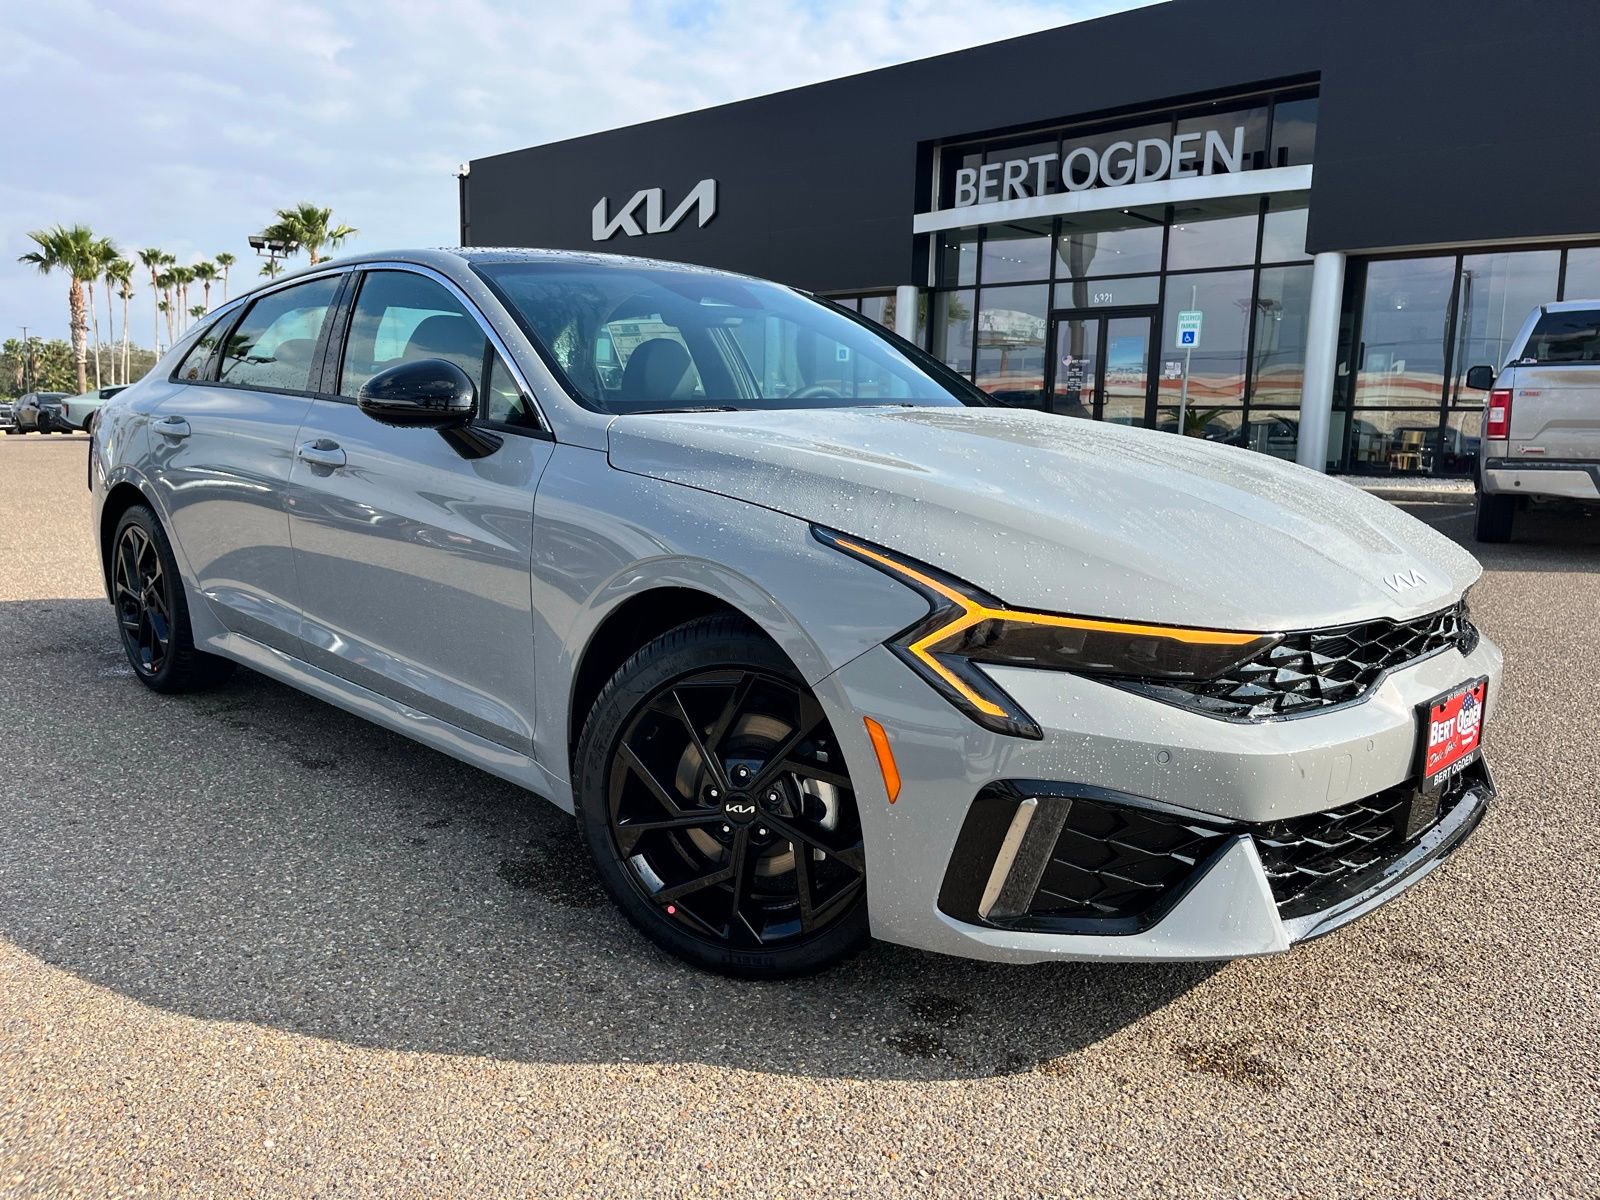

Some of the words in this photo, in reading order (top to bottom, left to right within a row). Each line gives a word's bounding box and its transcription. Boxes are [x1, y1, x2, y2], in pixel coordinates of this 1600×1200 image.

[955, 153, 1058, 208] BERT
[1062, 126, 1245, 191] OGDEN
[592, 178, 716, 241] KIA
[1383, 569, 1427, 593] KIA
[1429, 717, 1456, 747] BERT
[1457, 702, 1482, 733] OGDEN
[1433, 767, 1452, 786] BERT
[1452, 752, 1474, 773] OGDEN
[725, 804, 755, 813] KIA
